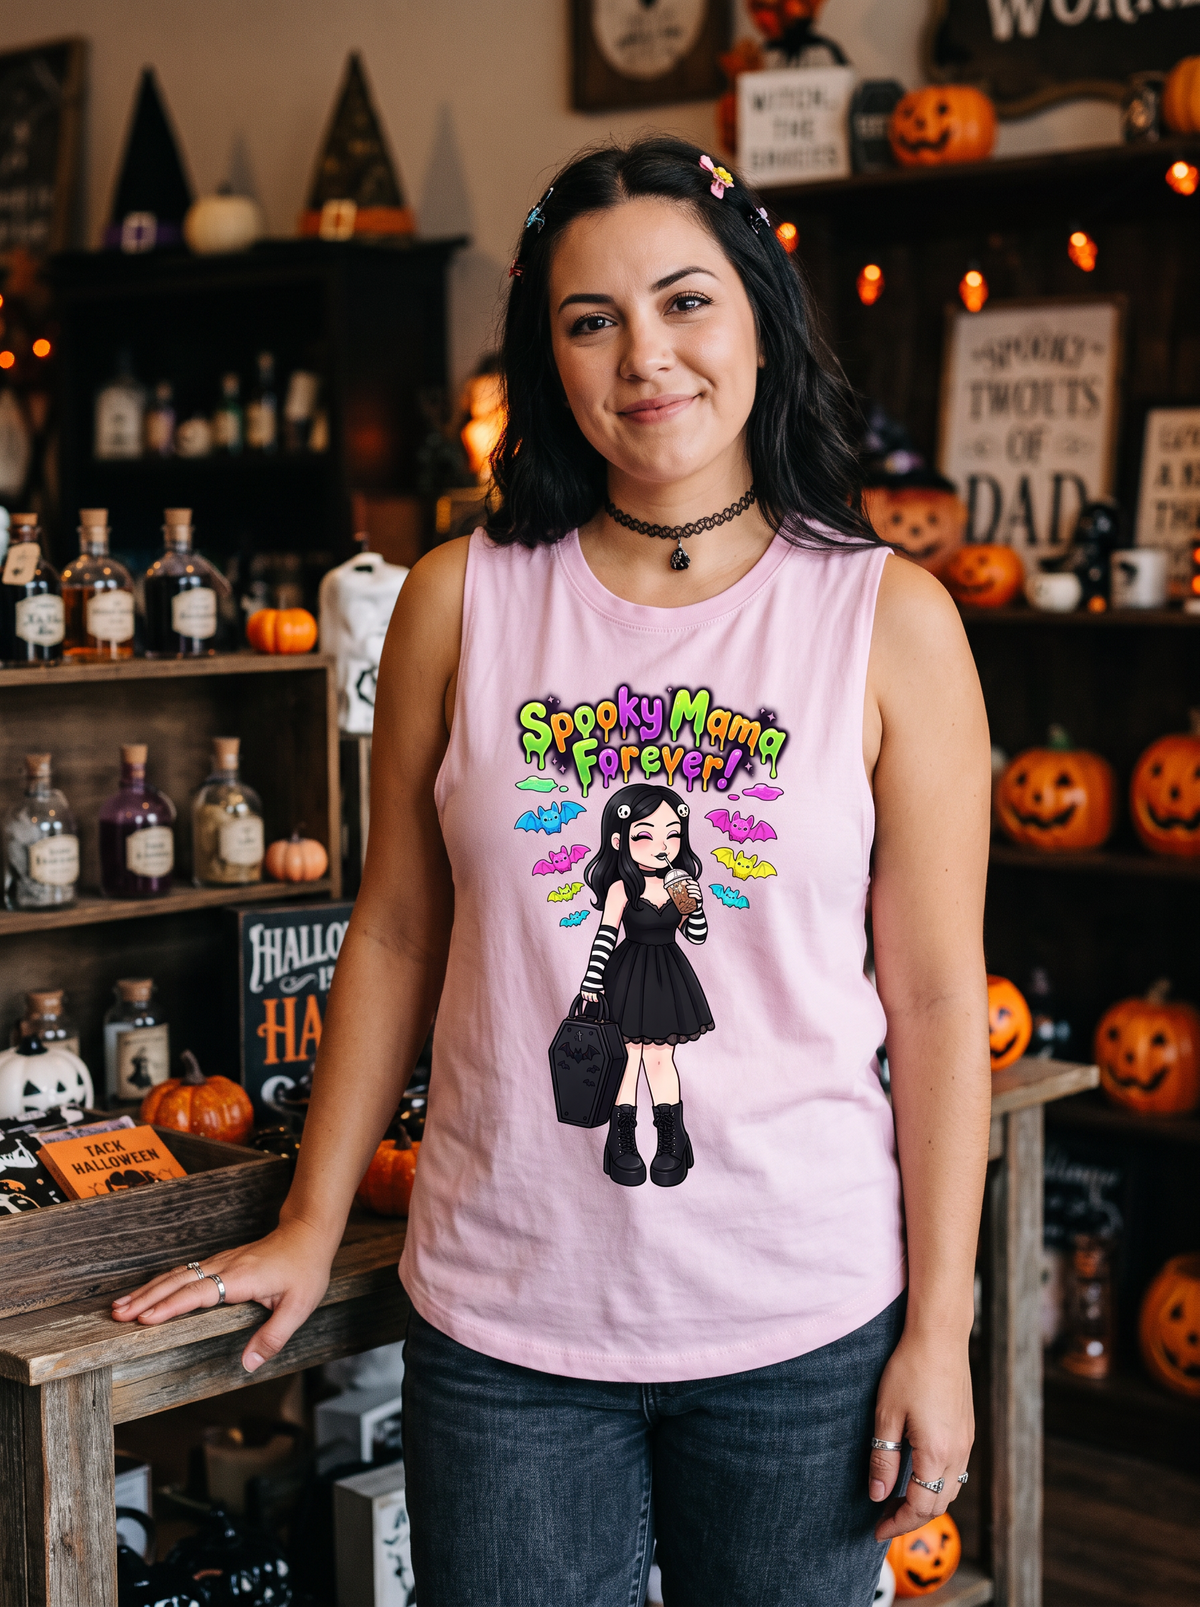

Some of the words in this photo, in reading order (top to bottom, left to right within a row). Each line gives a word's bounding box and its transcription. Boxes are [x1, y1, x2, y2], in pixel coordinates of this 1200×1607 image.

[965, 470, 1089, 546] DAD
[520, 686, 663, 770] Spooky
[669, 688, 787, 779] Mama
[571, 737, 743, 798] Forever!
[249, 921, 349, 994] HALLO
[71, 1148, 160, 1175] HALLOWEEN
[84, 1140, 127, 1158] TACK
